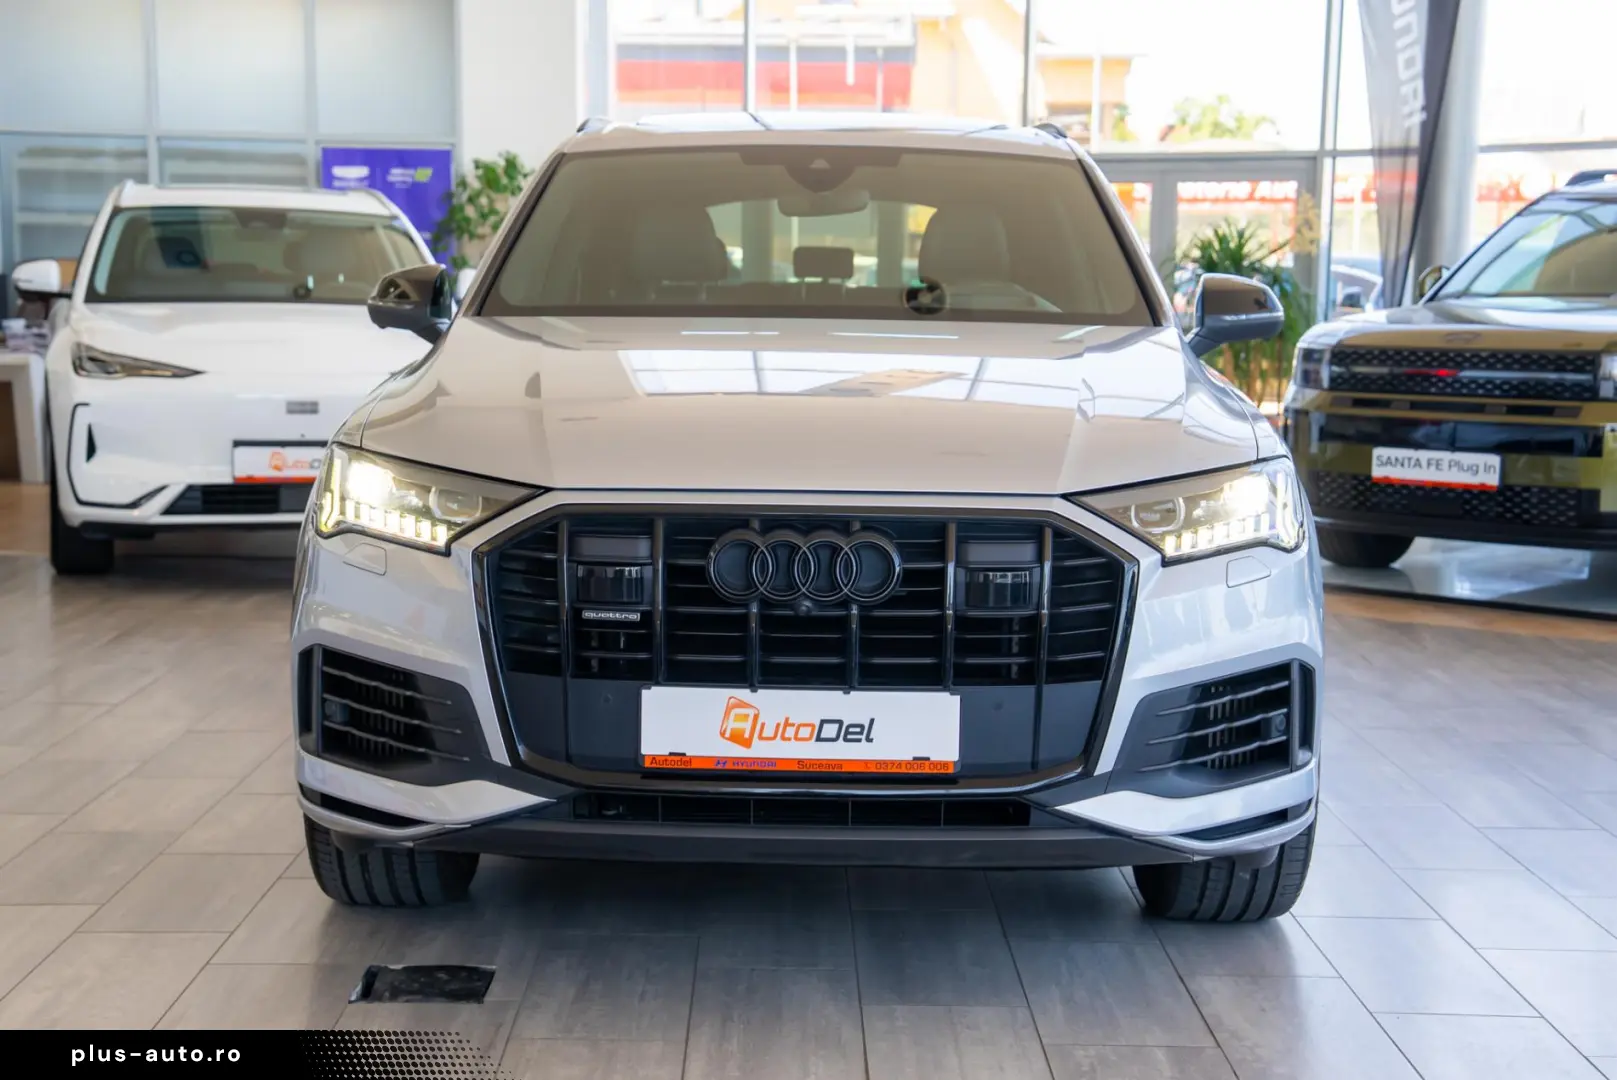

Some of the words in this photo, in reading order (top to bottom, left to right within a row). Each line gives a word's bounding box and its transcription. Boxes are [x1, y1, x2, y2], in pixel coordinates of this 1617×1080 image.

[1376, 454, 1423, 470] SANTA
[1427, 458, 1444, 471] FE
[1448, 460, 1480, 476] Plug
[584, 611, 638, 620] quattro
[719, 696, 875, 749] AutoDel
[650, 757, 692, 768] Autodel
[732, 760, 777, 769] HYUNDAI
[797, 760, 843, 771] Suceava
[875, 763, 901, 771] 0374
